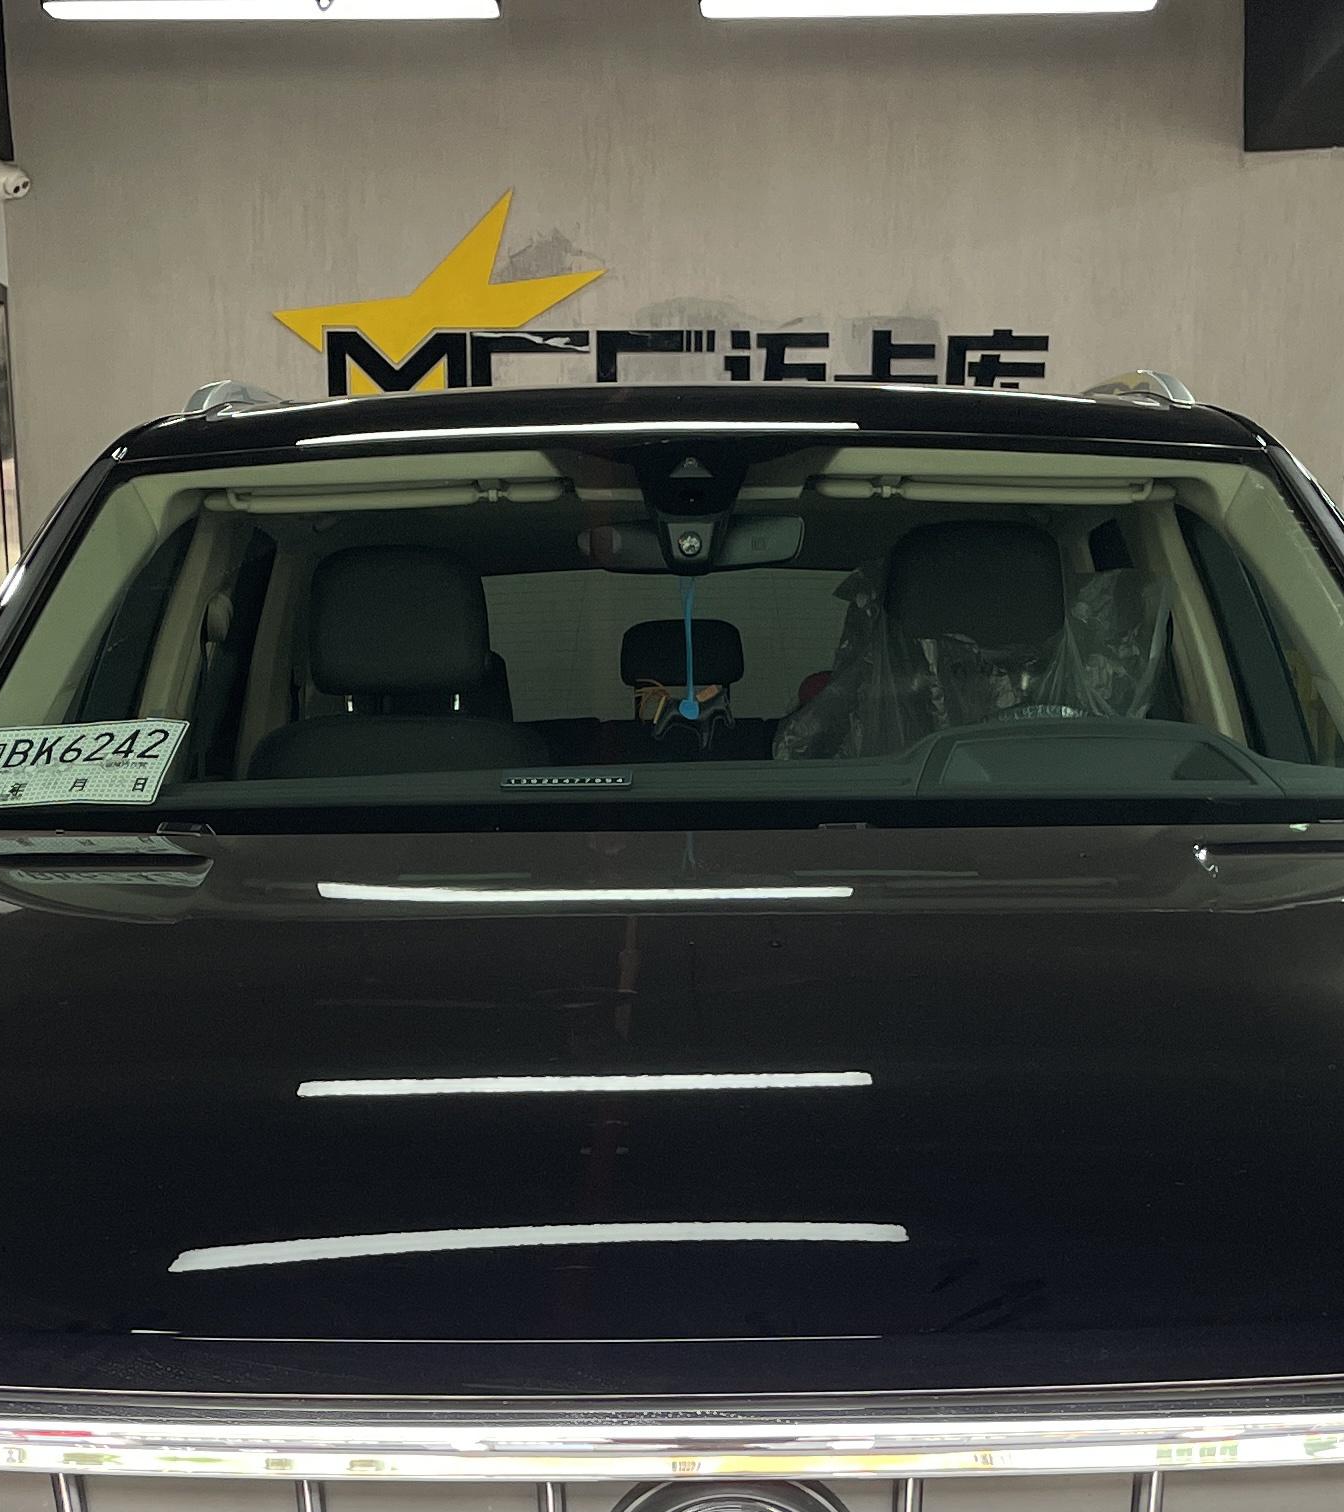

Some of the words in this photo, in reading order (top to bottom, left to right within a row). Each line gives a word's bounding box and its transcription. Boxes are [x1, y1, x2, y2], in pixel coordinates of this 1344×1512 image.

[9, 781, 26, 796] 年
[69, 777, 88, 792] 月
[131, 777, 148, 792] 日
